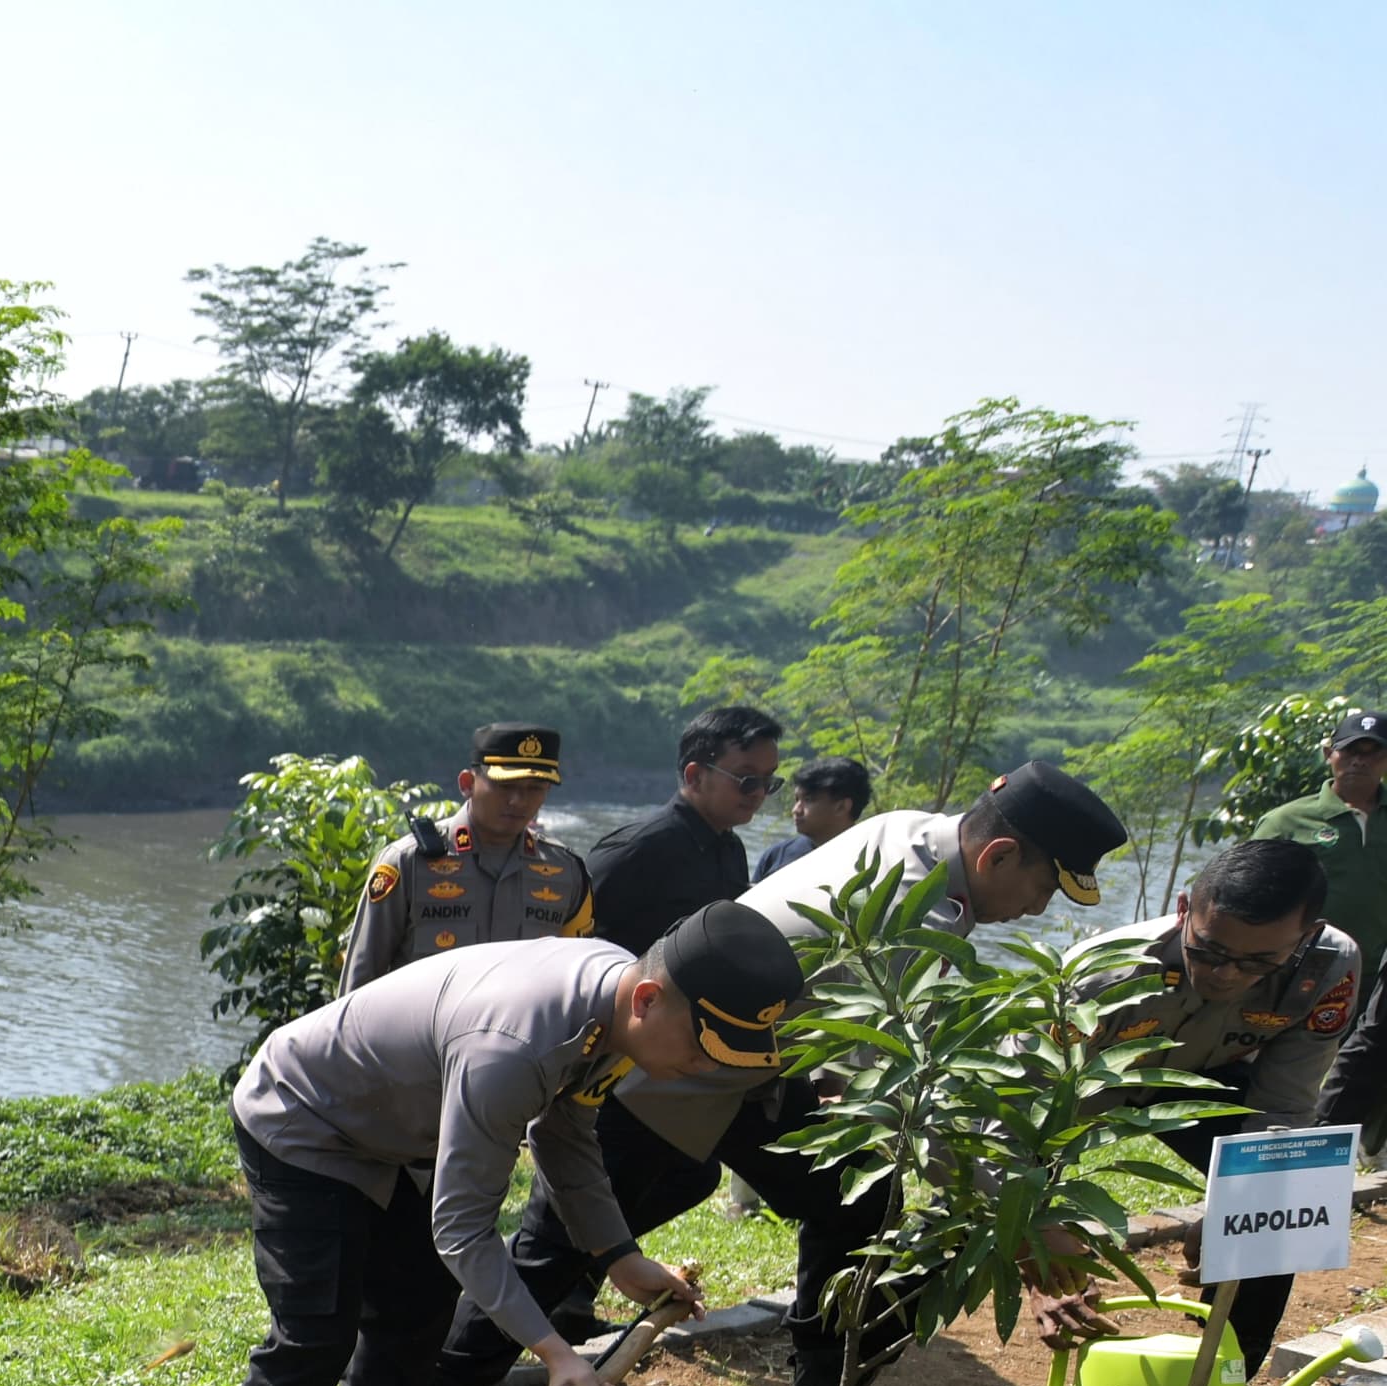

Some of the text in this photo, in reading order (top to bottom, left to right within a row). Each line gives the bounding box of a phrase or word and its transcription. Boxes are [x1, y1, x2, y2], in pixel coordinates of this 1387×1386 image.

[421, 906, 471, 919] ANDRY
[525, 907, 564, 925] POLRI
[1304, 1139, 1328, 1148] HIDUP
[1223, 1206, 1330, 1236] KAPOLDA
